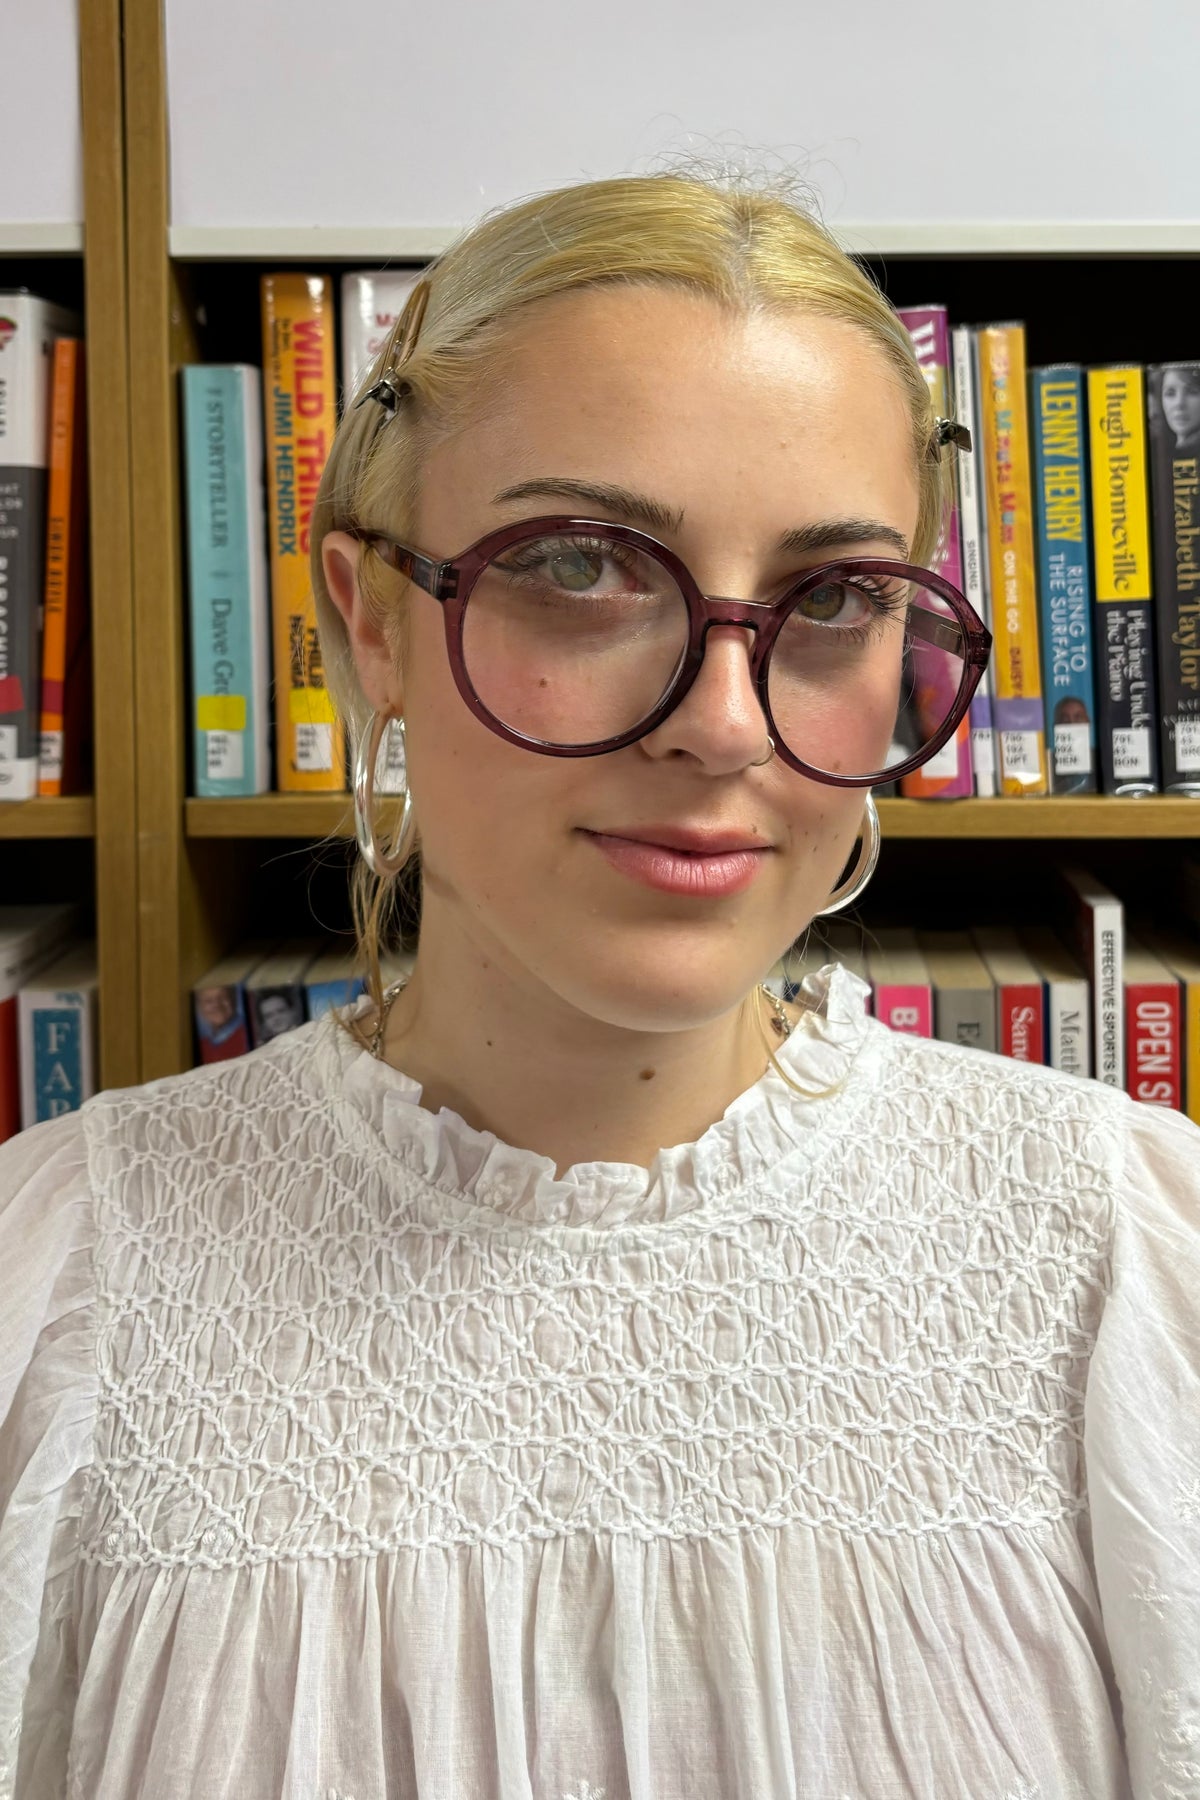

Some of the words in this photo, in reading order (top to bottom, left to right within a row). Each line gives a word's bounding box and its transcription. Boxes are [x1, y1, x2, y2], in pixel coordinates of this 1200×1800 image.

[293, 319, 324, 418] WILD
[274, 385, 293, 437] JIMI
[1041, 382, 1079, 458] LENNY
[1100, 381, 1131, 449] Hugh
[207, 402, 229, 548] STORYTELLER
[277, 445, 297, 556] HENDRIX
[1044, 464, 1083, 542] HENRY
[1109, 455, 1137, 592] Bonneville
[1173, 458, 1200, 592] Elizabeth
[1049, 552, 1065, 591] THE
[1067, 565, 1085, 638] RISING
[211, 599, 232, 655] Dave
[1006, 607, 1019, 634] GO
[1051, 596, 1070, 687] SURFACE
[1070, 642, 1087, 672] TO
[1172, 597, 1200, 690] Taylor
[1129, 681, 1151, 729] Unde
[1101, 930, 1115, 1007] EFFECTIVE
[890, 1006, 919, 1035] B
[1060, 1010, 1081, 1075] Matth
[1103, 1011, 1117, 1072] SPORTS
[1136, 1001, 1172, 1075] OPEN
